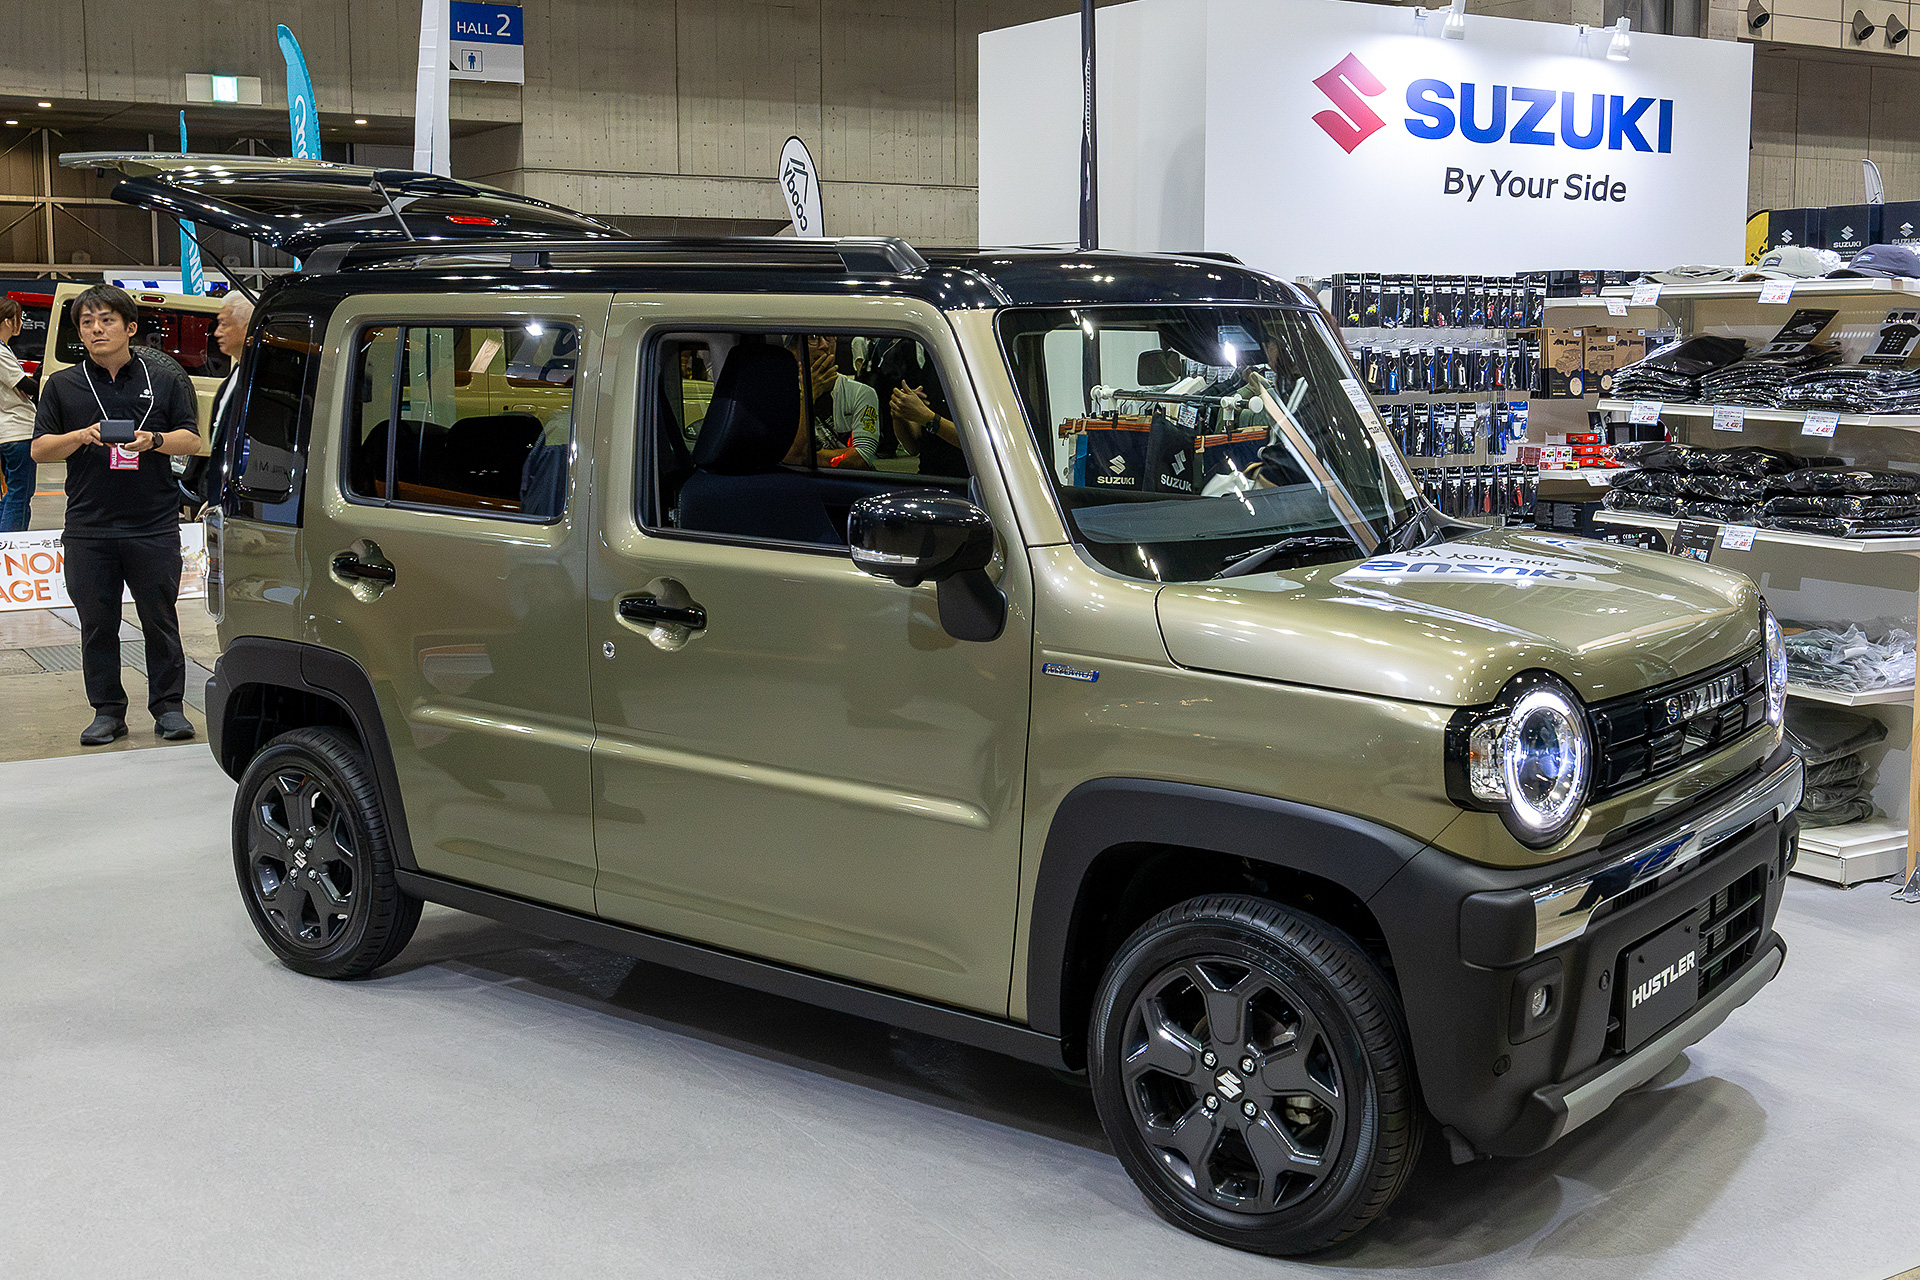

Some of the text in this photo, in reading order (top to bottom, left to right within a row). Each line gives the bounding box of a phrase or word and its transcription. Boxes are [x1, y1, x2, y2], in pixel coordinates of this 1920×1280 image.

[456, 13, 511, 37] HALL 2
[1404, 78, 1674, 154] SUZUKI
[1443, 167, 1627, 202] By Your Side
[1833, 241, 1862, 249] SUZUKI
[1097, 476, 1135, 485] SUZUKI
[1160, 474, 1192, 492] SUZUK
[1666, 673, 1739, 725] SUZUKI
[1631, 950, 1696, 1009] HUSTLER
